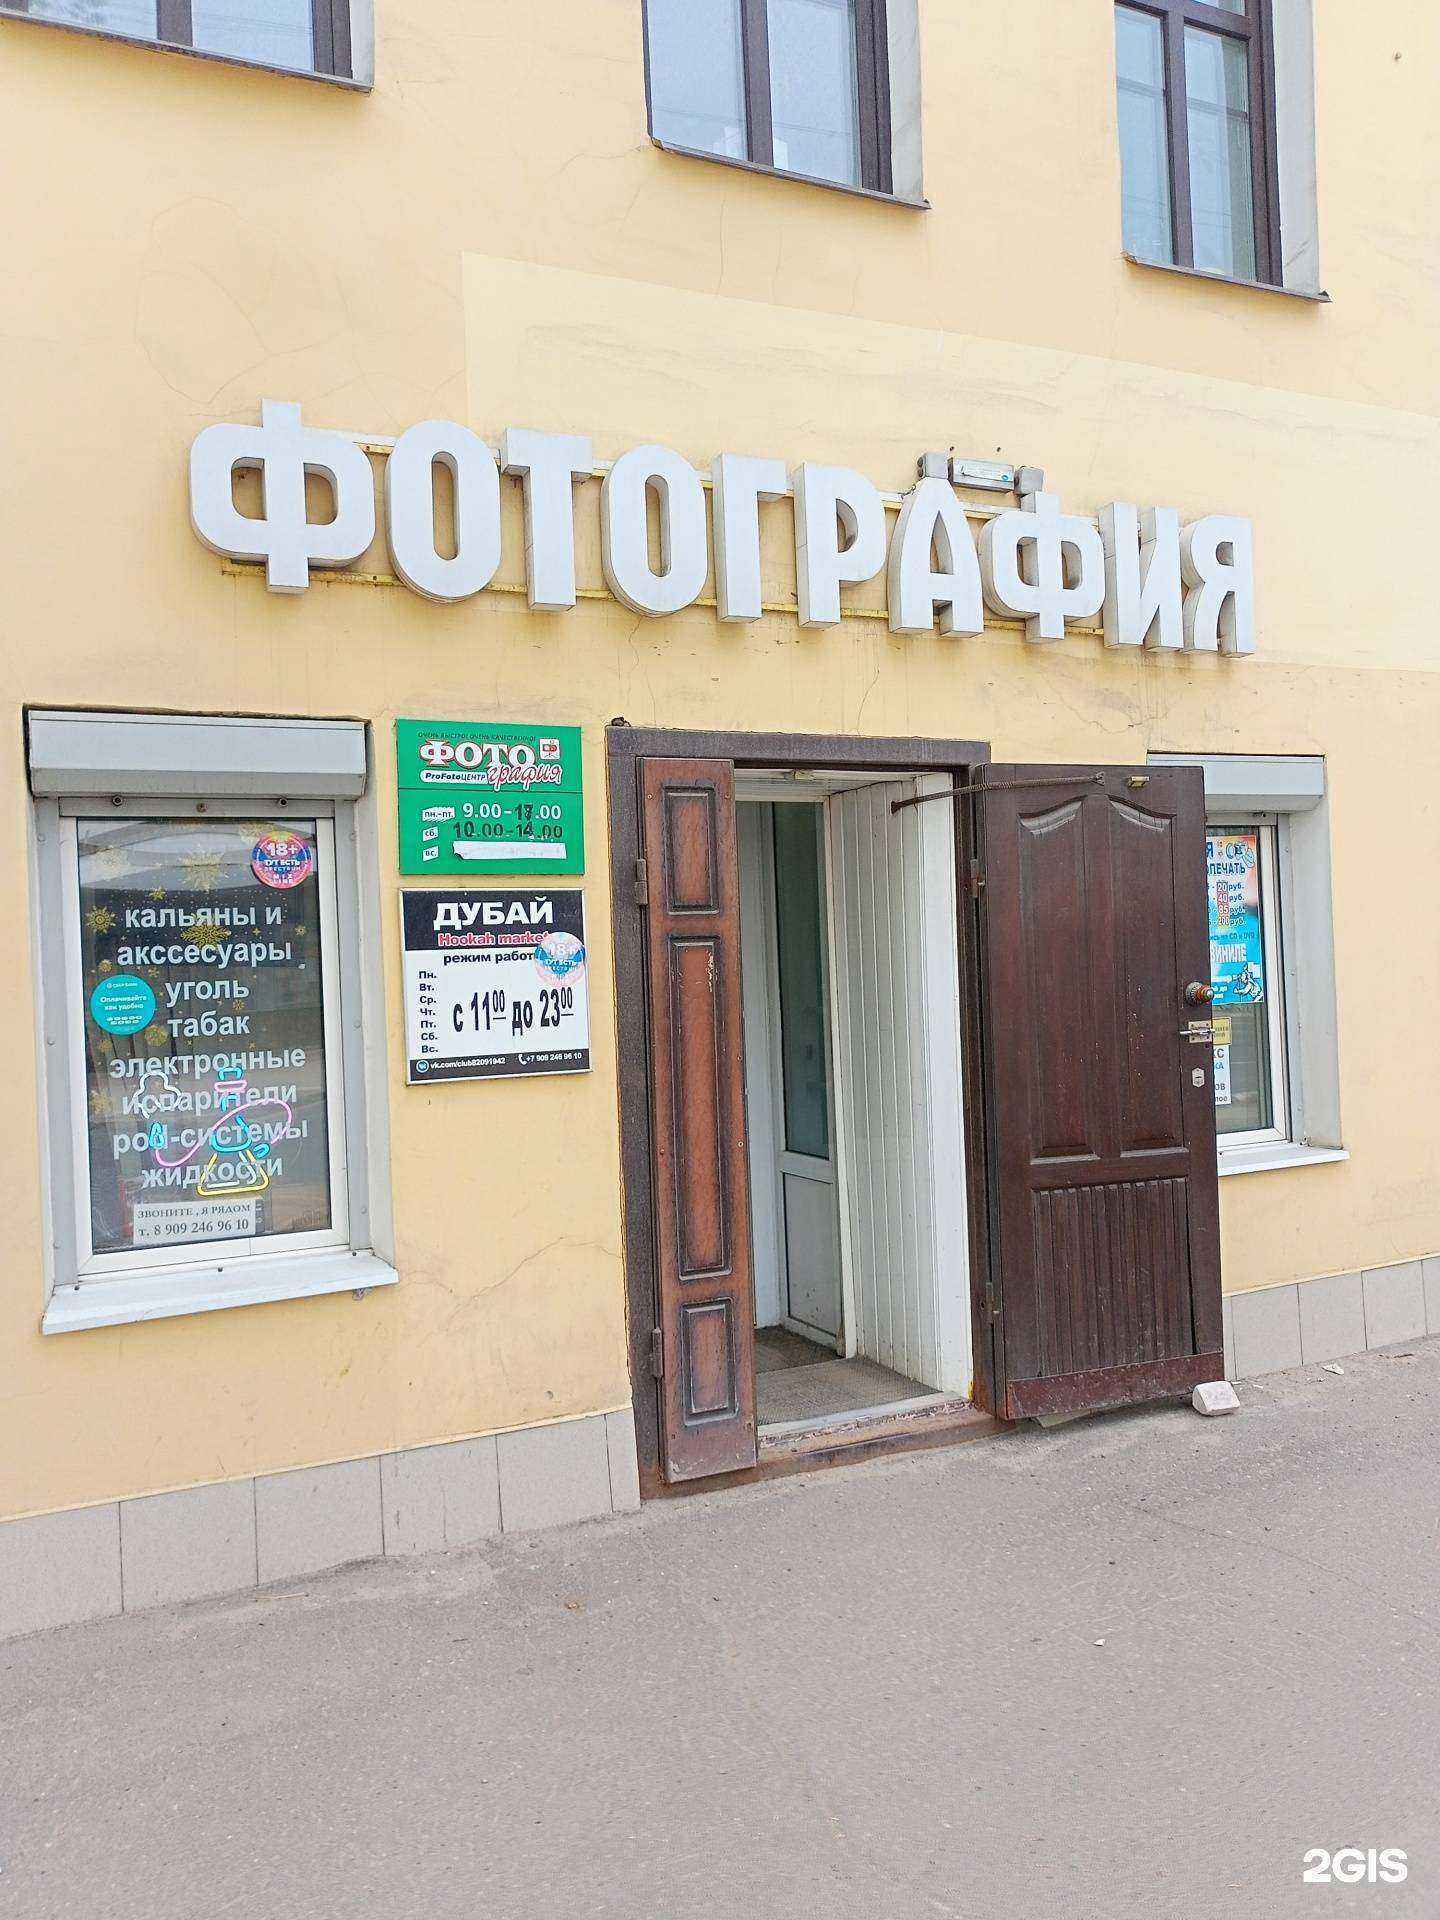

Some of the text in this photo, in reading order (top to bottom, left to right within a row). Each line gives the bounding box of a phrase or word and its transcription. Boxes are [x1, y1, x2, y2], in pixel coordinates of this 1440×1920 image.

[189, 399, 1254, 659] ФОТОГРАФИЯ
[419, 739, 536, 770] ФОТО
[266, 842, 298, 856] 18+
[125, 906, 282, 928] кальяны и
[433, 895, 554, 931] ДУБАЙ
[437, 931, 549, 947] Hookah marke
[117, 942, 292, 969] акссесуары
[443, 950, 534, 965] режим работ
[418, 970, 437, 979] Пн.
[164, 980, 249, 1008] уголь
[419, 983, 435, 992] Вт.
[420, 995, 437, 1005] Ср.
[420, 1008, 436, 1017] Чт.
[512, 1000, 534, 1036] до
[166, 1010, 251, 1038] табак
[420, 1020, 437, 1029] Пт.
[421, 1032, 438, 1041] Сб.
[421, 1045, 438, 1053] Вс.
[109, 1047, 306, 1079] электронные
[141, 1157, 284, 1190] жидкости
[211, 1204, 250, 1215] РЯДОМ
[154, 1224, 161, 1235] 8
[165, 1222, 188, 1235] 909
[191, 1220, 213, 1233] 246
[217, 1219, 232, 1231] 96
[236, 1218, 249, 1230] 10
